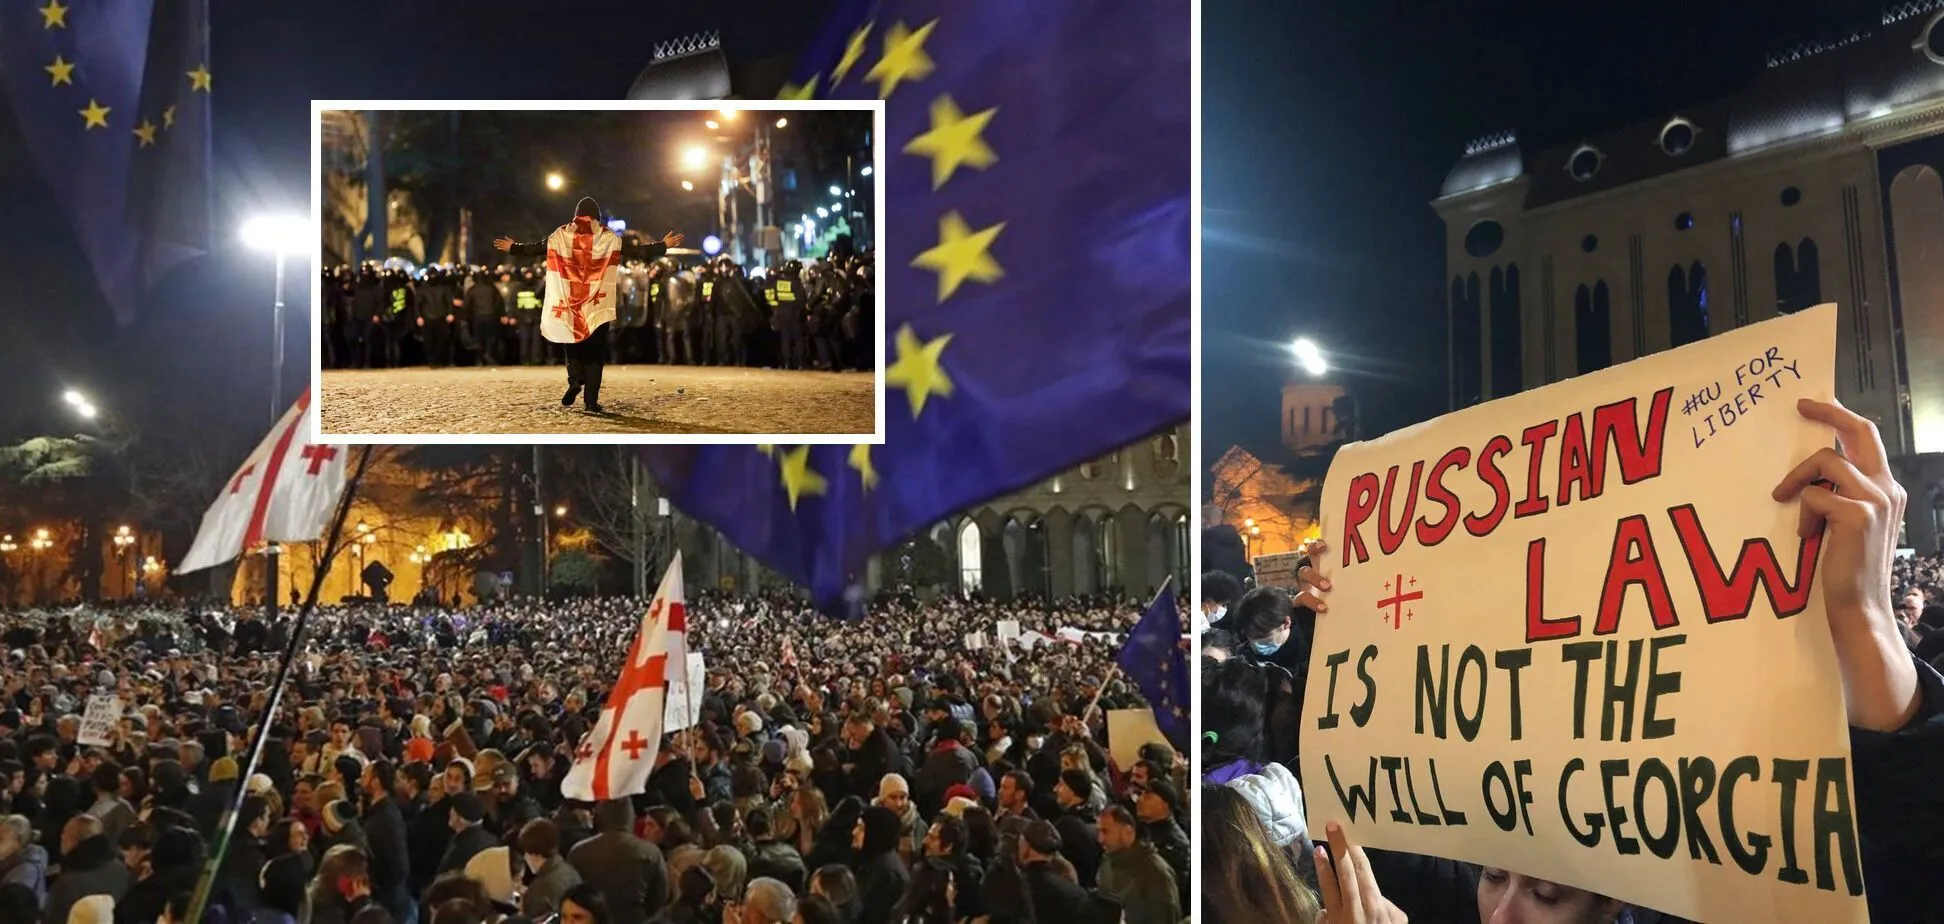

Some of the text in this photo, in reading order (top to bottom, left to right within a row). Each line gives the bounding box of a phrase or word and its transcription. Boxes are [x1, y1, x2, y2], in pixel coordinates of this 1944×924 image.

[1692, 360, 1801, 449] LIBERTY
[1735, 347, 1784, 386] FOR
[1342, 387, 1674, 567] RUSSIAN
[1525, 482, 1836, 642] LAW
[1317, 634, 1687, 742] IS NOT THE
[1325, 754, 1864, 896] WILL OF GEORGIA
